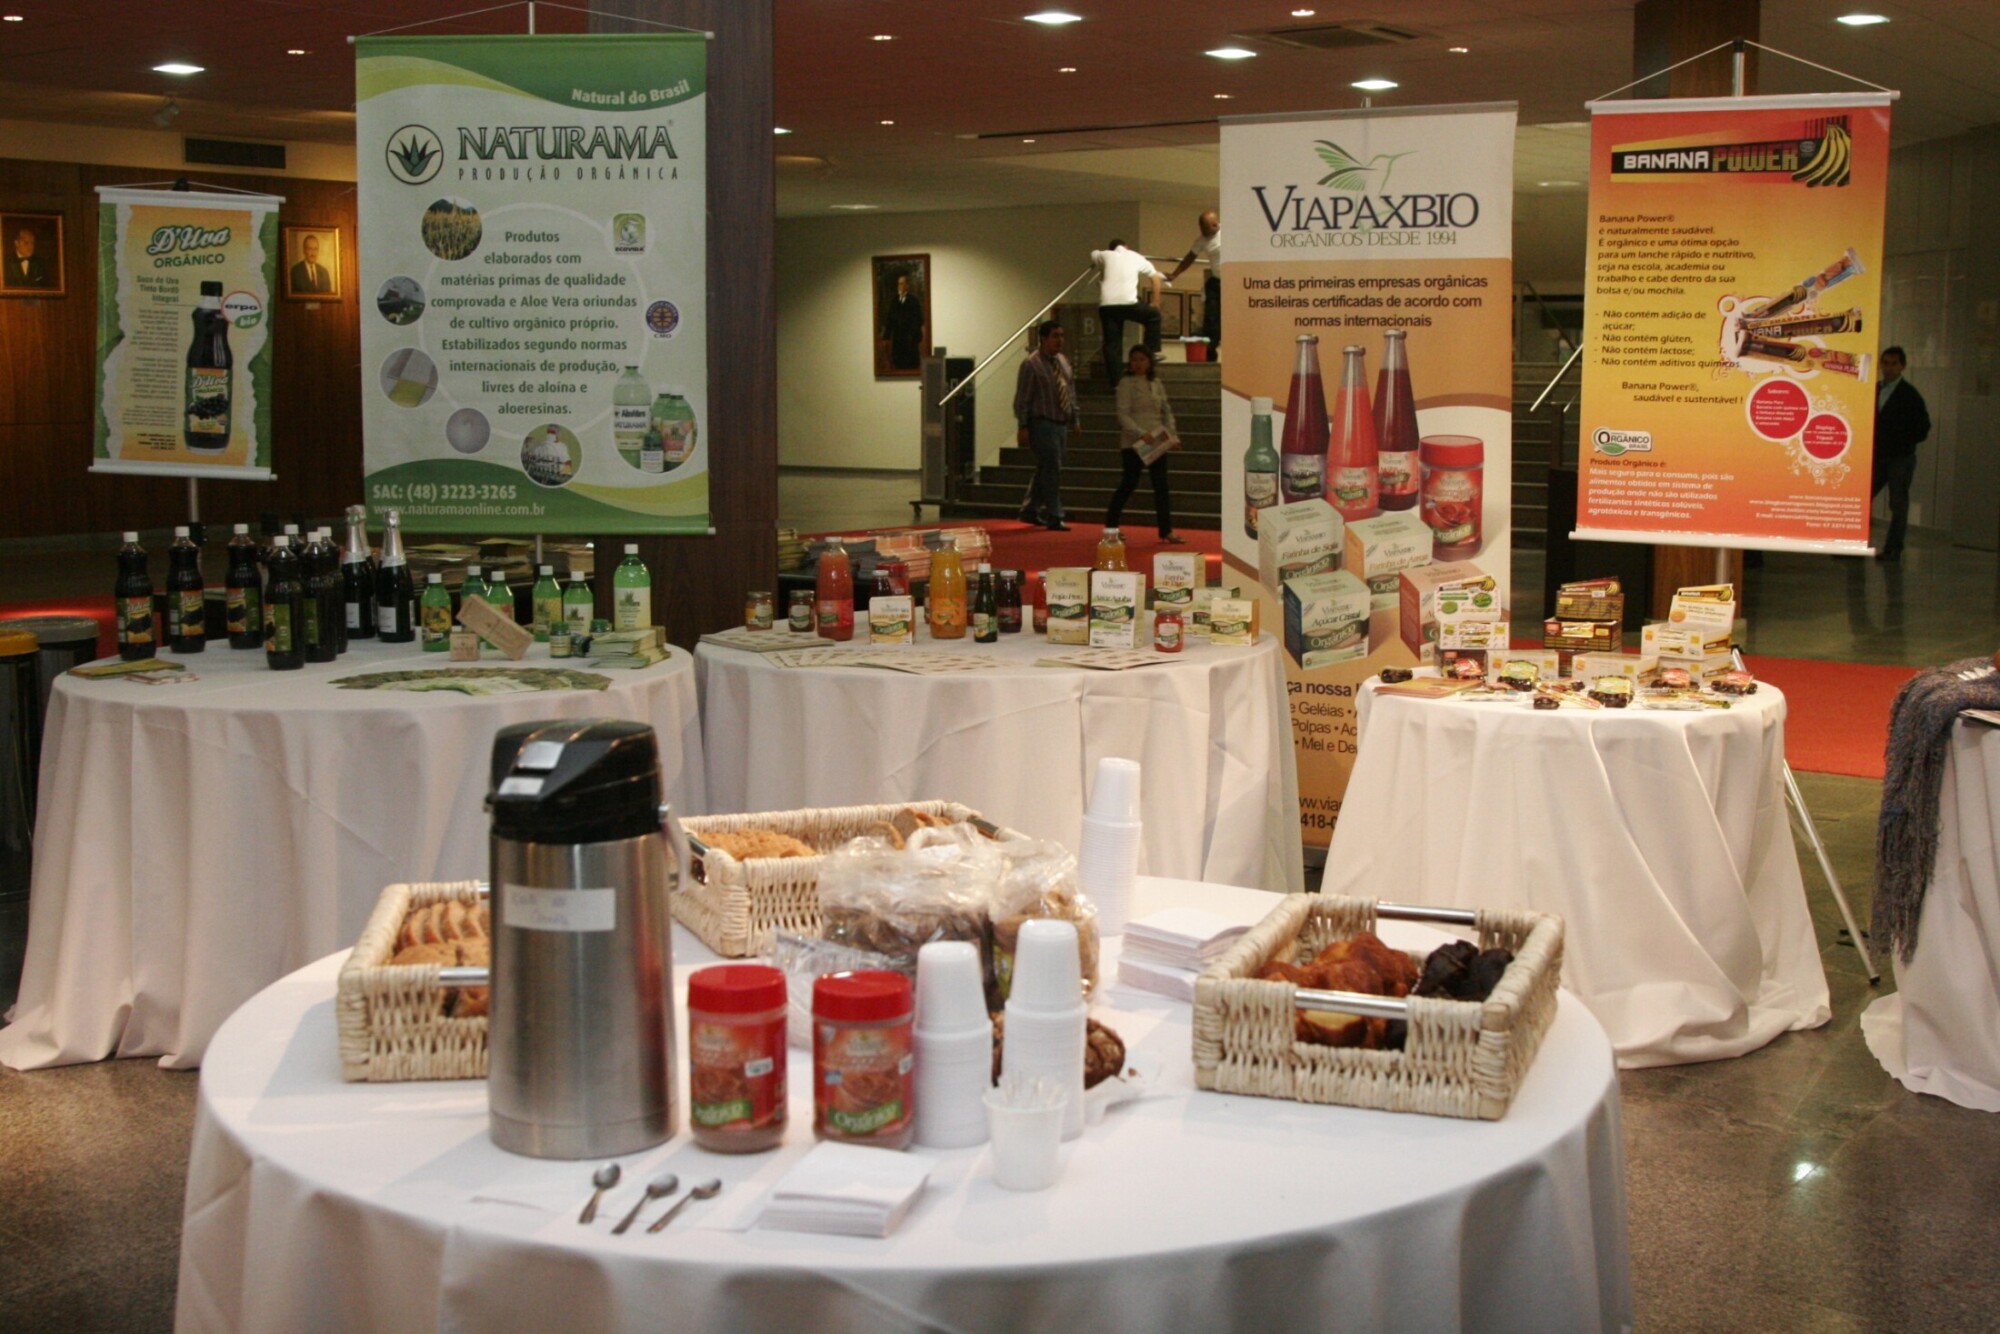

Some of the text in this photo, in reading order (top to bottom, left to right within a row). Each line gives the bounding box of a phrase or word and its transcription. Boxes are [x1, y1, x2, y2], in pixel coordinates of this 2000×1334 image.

[572, 80, 689, 106] Natural do Brasil
[458, 126, 678, 160] NATURAMA
[1623, 142, 1798, 172] BANANA POWER
[458, 164, 679, 182] PRODUÇÃO ORGÂNICA
[1252, 185, 1479, 231] VIAPAXBIO
[1600, 215, 1635, 223] Banana
[1599, 226, 1715, 235] é naturalmente saudável.
[147, 226, 232, 255] D'Uva
[505, 231, 559, 243] Produtos
[1270, 230, 1457, 248] ORGÂNICOS DESDE 1994
[1599, 238, 1605, 247] É
[1607, 238, 1648, 249] orgânico
[1681, 238, 1708, 247] ótima
[1711, 238, 1739, 249] opção
[154, 252, 226, 268] ORGÂNICO
[484, 252, 581, 264] elaborados com
[1598, 252, 1618, 260] para
[1638, 250, 1669, 259] lanche
[1672, 250, 1701, 261] rápido
[1712, 250, 1756, 260] nutritivo,
[1597, 263, 1615, 273] seja
[1632, 263, 1663, 272] escola,
[1665, 263, 1710, 271] academia
[166, 276, 179, 284] Uva
[441, 273, 626, 288] matérias primas de qualidade
[1243, 274, 1488, 292] Uma das primeiras empresas orgânicas
[1597, 275, 1637, 283] trabalho
[1646, 275, 1668, 283] cabe
[1671, 275, 1702, 283] dentro
[1705, 275, 1716, 283] da
[1597, 286, 1686, 296] bolsa e/ou mochila.
[152, 294, 179, 303] Integral
[431, 296, 637, 310] comprovada e Aloe Vera oriundas
[1248, 295, 1482, 308] brasileiras certificadas de acordo com
[1294, 314, 1432, 327] normas internacionais
[1603, 310, 1706, 321] Não contém adição de
[450, 317, 619, 333] de cultivo orgânico próprio.
[1602, 333, 1620, 343] Não
[1623, 334, 1658, 343] contém
[442, 339, 627, 353] Estabilizados segundo normas
[1602, 346, 1620, 355] Não
[1623, 346, 1657, 355] contém
[450, 360, 620, 375] internacionais de produção,
[1601, 357, 1619, 366] Não
[1622, 358, 1657, 367] contém
[1660, 358, 1696, 367] aditivos
[482, 382, 587, 393] livres de aloína e
[1622, 382, 1655, 391] Banana
[1633, 393, 1674, 402] saudável
[1685, 394, 1738, 404] sustentável
[498, 403, 572, 415] aloeresinas.
[1598, 431, 1650, 444] ORGÂNICO
[1590, 458, 1621, 466] Produto
[1623, 459, 1658, 468] Orgânico
[1636, 470, 1654, 478] para
[1702, 472, 1718, 480] pois
[1589, 478, 1626, 486] alimentos
[1628, 479, 1656, 487] obtidos
[1672, 481, 1701, 489] sistema
[1703, 482, 1713, 490] de
[373, 483, 517, 502] SAC: (48) 3223-3265
[1589, 488, 1625, 498] produção
[1627, 489, 1646, 497] onde
[1680, 492, 1718, 500] utilizados
[1312, 616, 1337, 628] Açúcar
[1311, 623, 1356, 649] Orgânico
[1306, 683, 1352, 697] nossa
[1299, 702, 1344, 718] Geléias
[1292, 718, 1331, 735] Polpas
[1302, 737, 1324, 751] Mel
[1326, 741, 1335, 751] e
